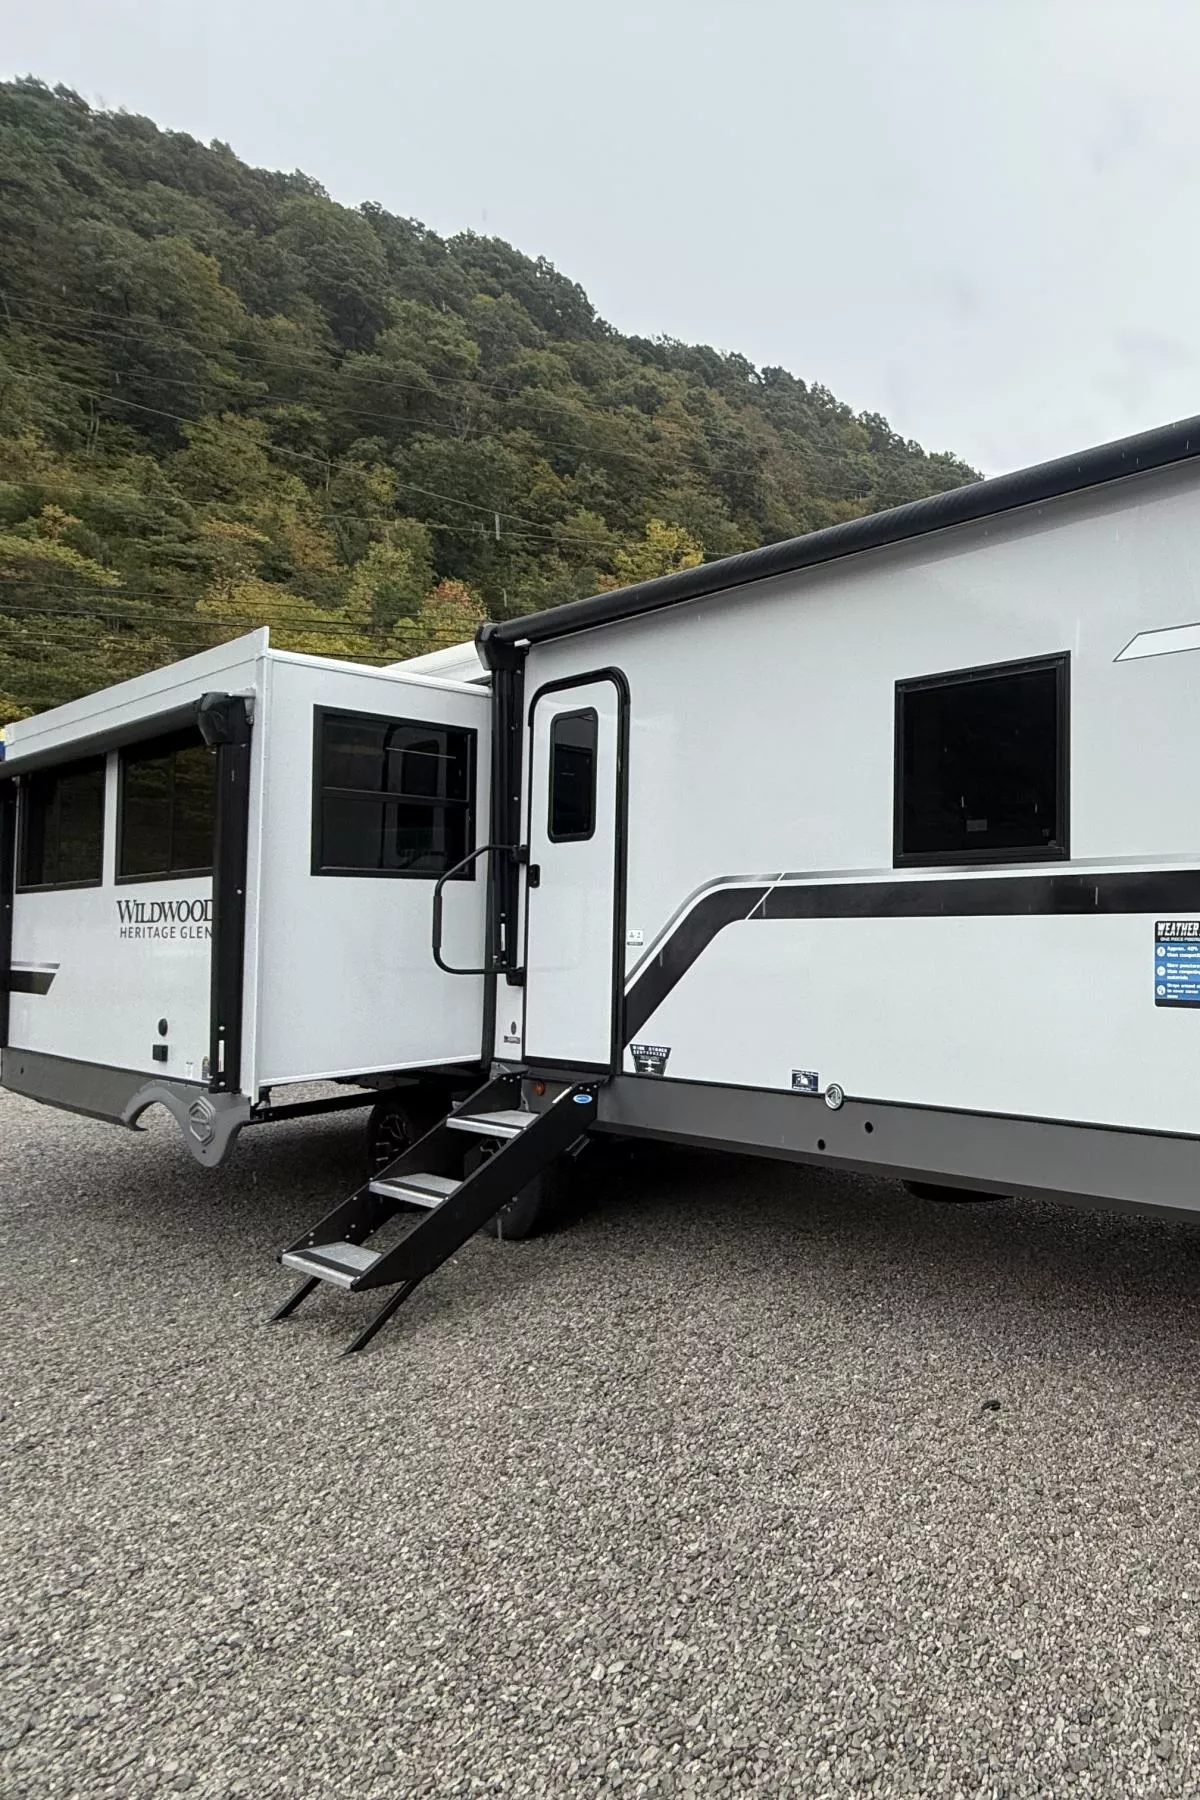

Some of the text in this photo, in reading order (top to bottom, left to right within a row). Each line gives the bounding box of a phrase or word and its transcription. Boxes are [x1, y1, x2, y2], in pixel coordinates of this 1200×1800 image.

[120, 926, 213, 939] HERITAGE GLEN
[1157, 922, 1199, 936] WEATHER
